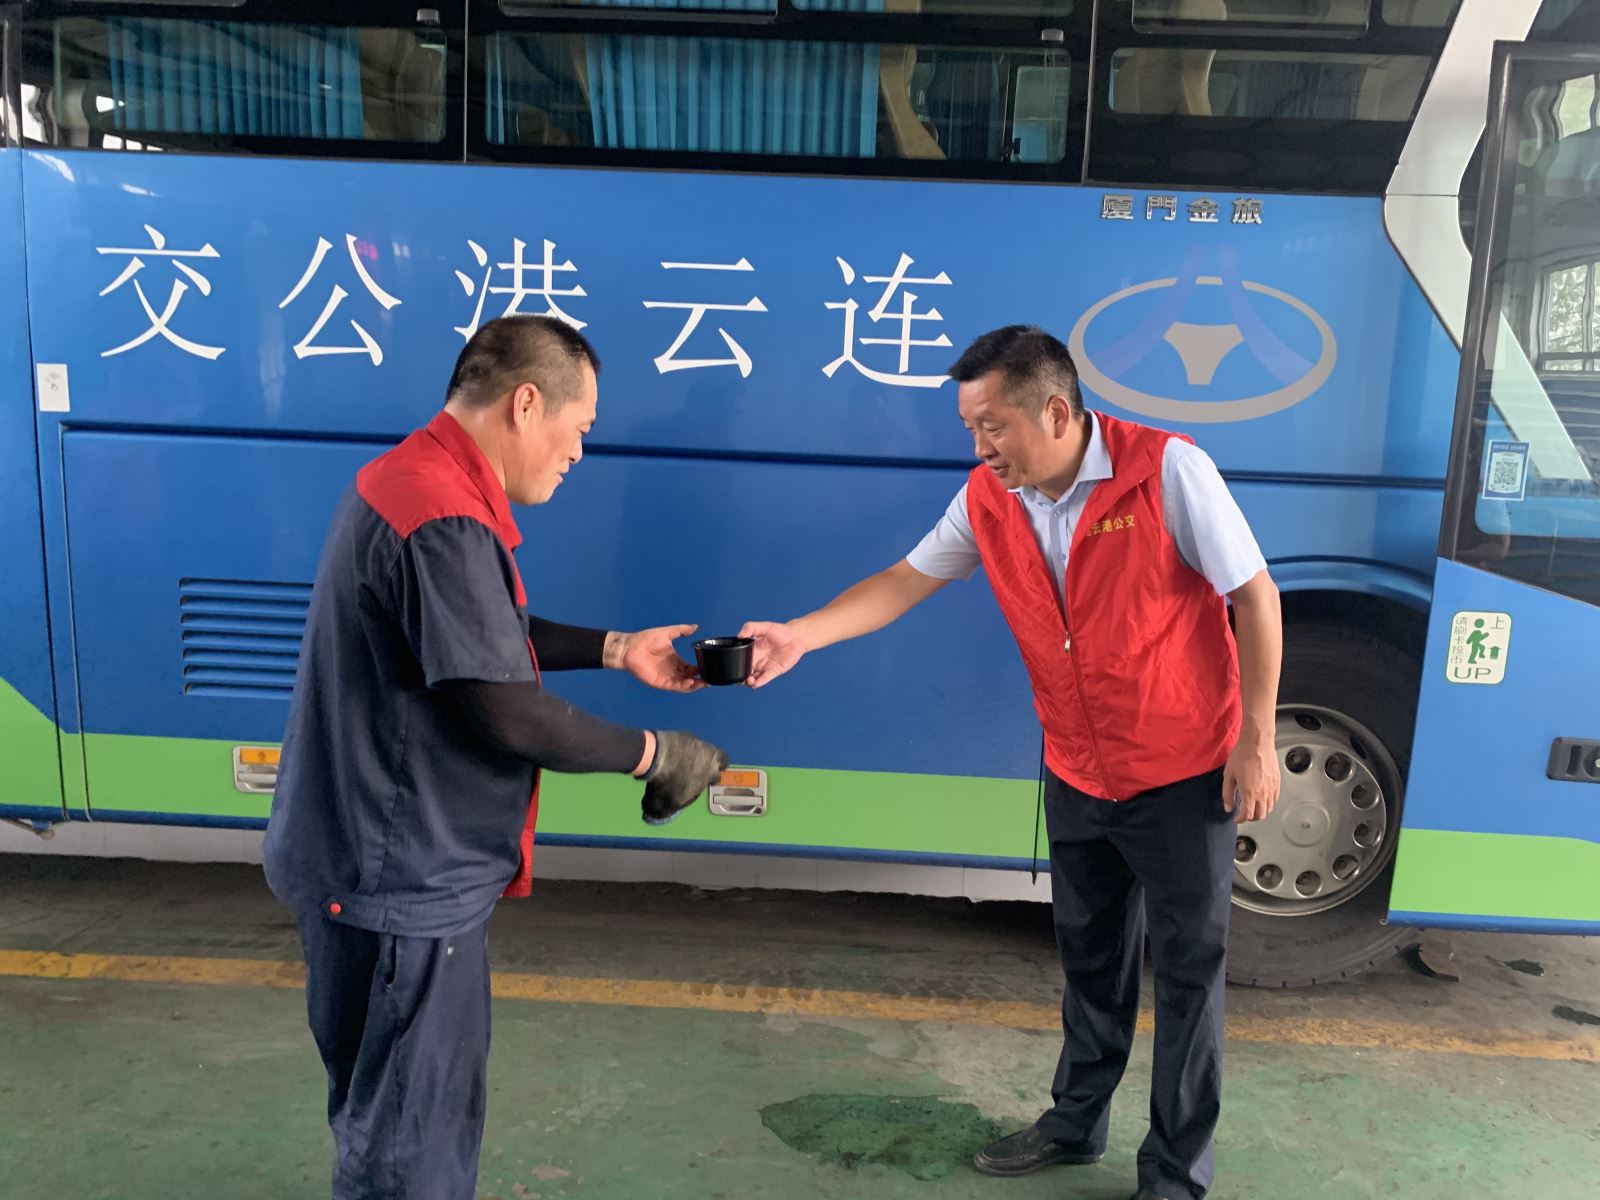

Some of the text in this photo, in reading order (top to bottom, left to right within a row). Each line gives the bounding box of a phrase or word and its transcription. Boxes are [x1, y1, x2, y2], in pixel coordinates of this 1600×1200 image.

[1086, 514, 1136, 537] 云港公交
[1489, 615, 1505, 630] 上
[1454, 666, 1492, 680] UP
